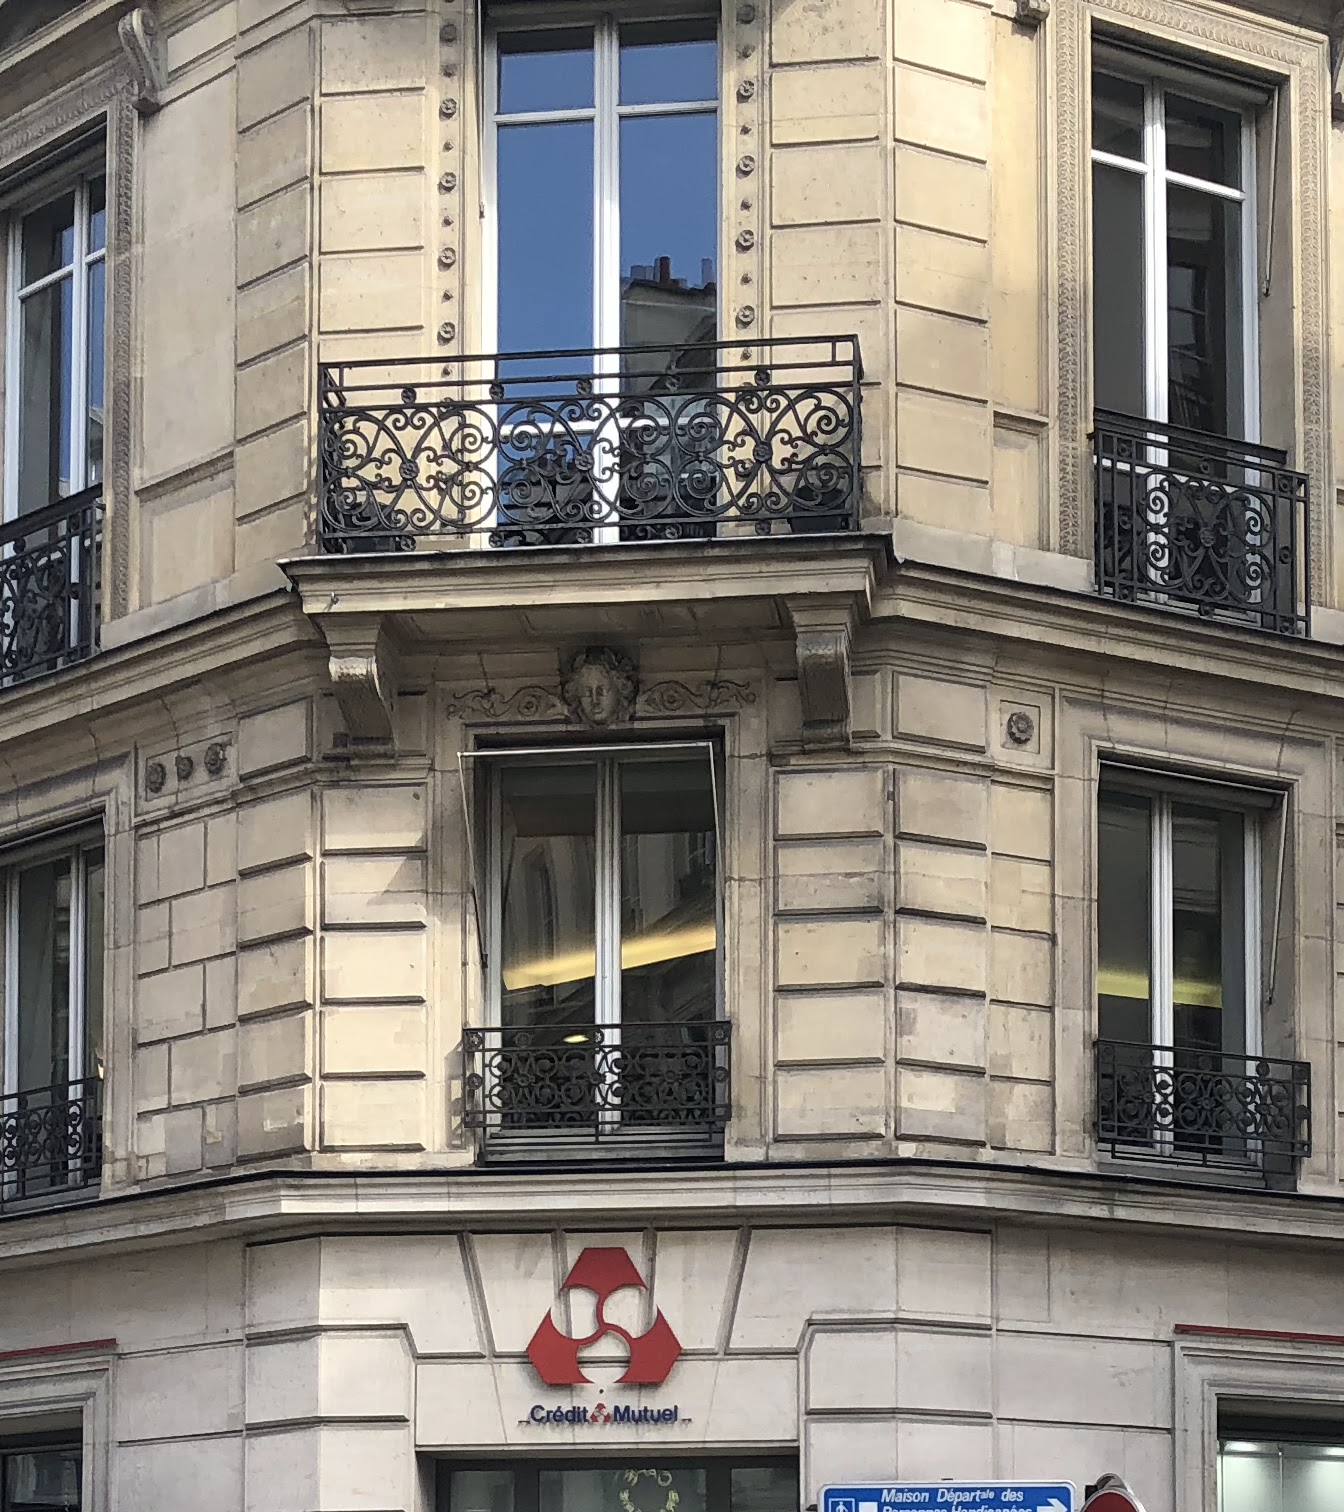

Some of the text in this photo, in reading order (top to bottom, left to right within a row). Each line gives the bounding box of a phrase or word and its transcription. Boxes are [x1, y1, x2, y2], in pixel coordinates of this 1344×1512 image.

[530, 1404, 679, 1423] Crédit Mutuel
[880, 1488, 930, 1503] Maison
[1000, 1488, 1024, 1502] des
